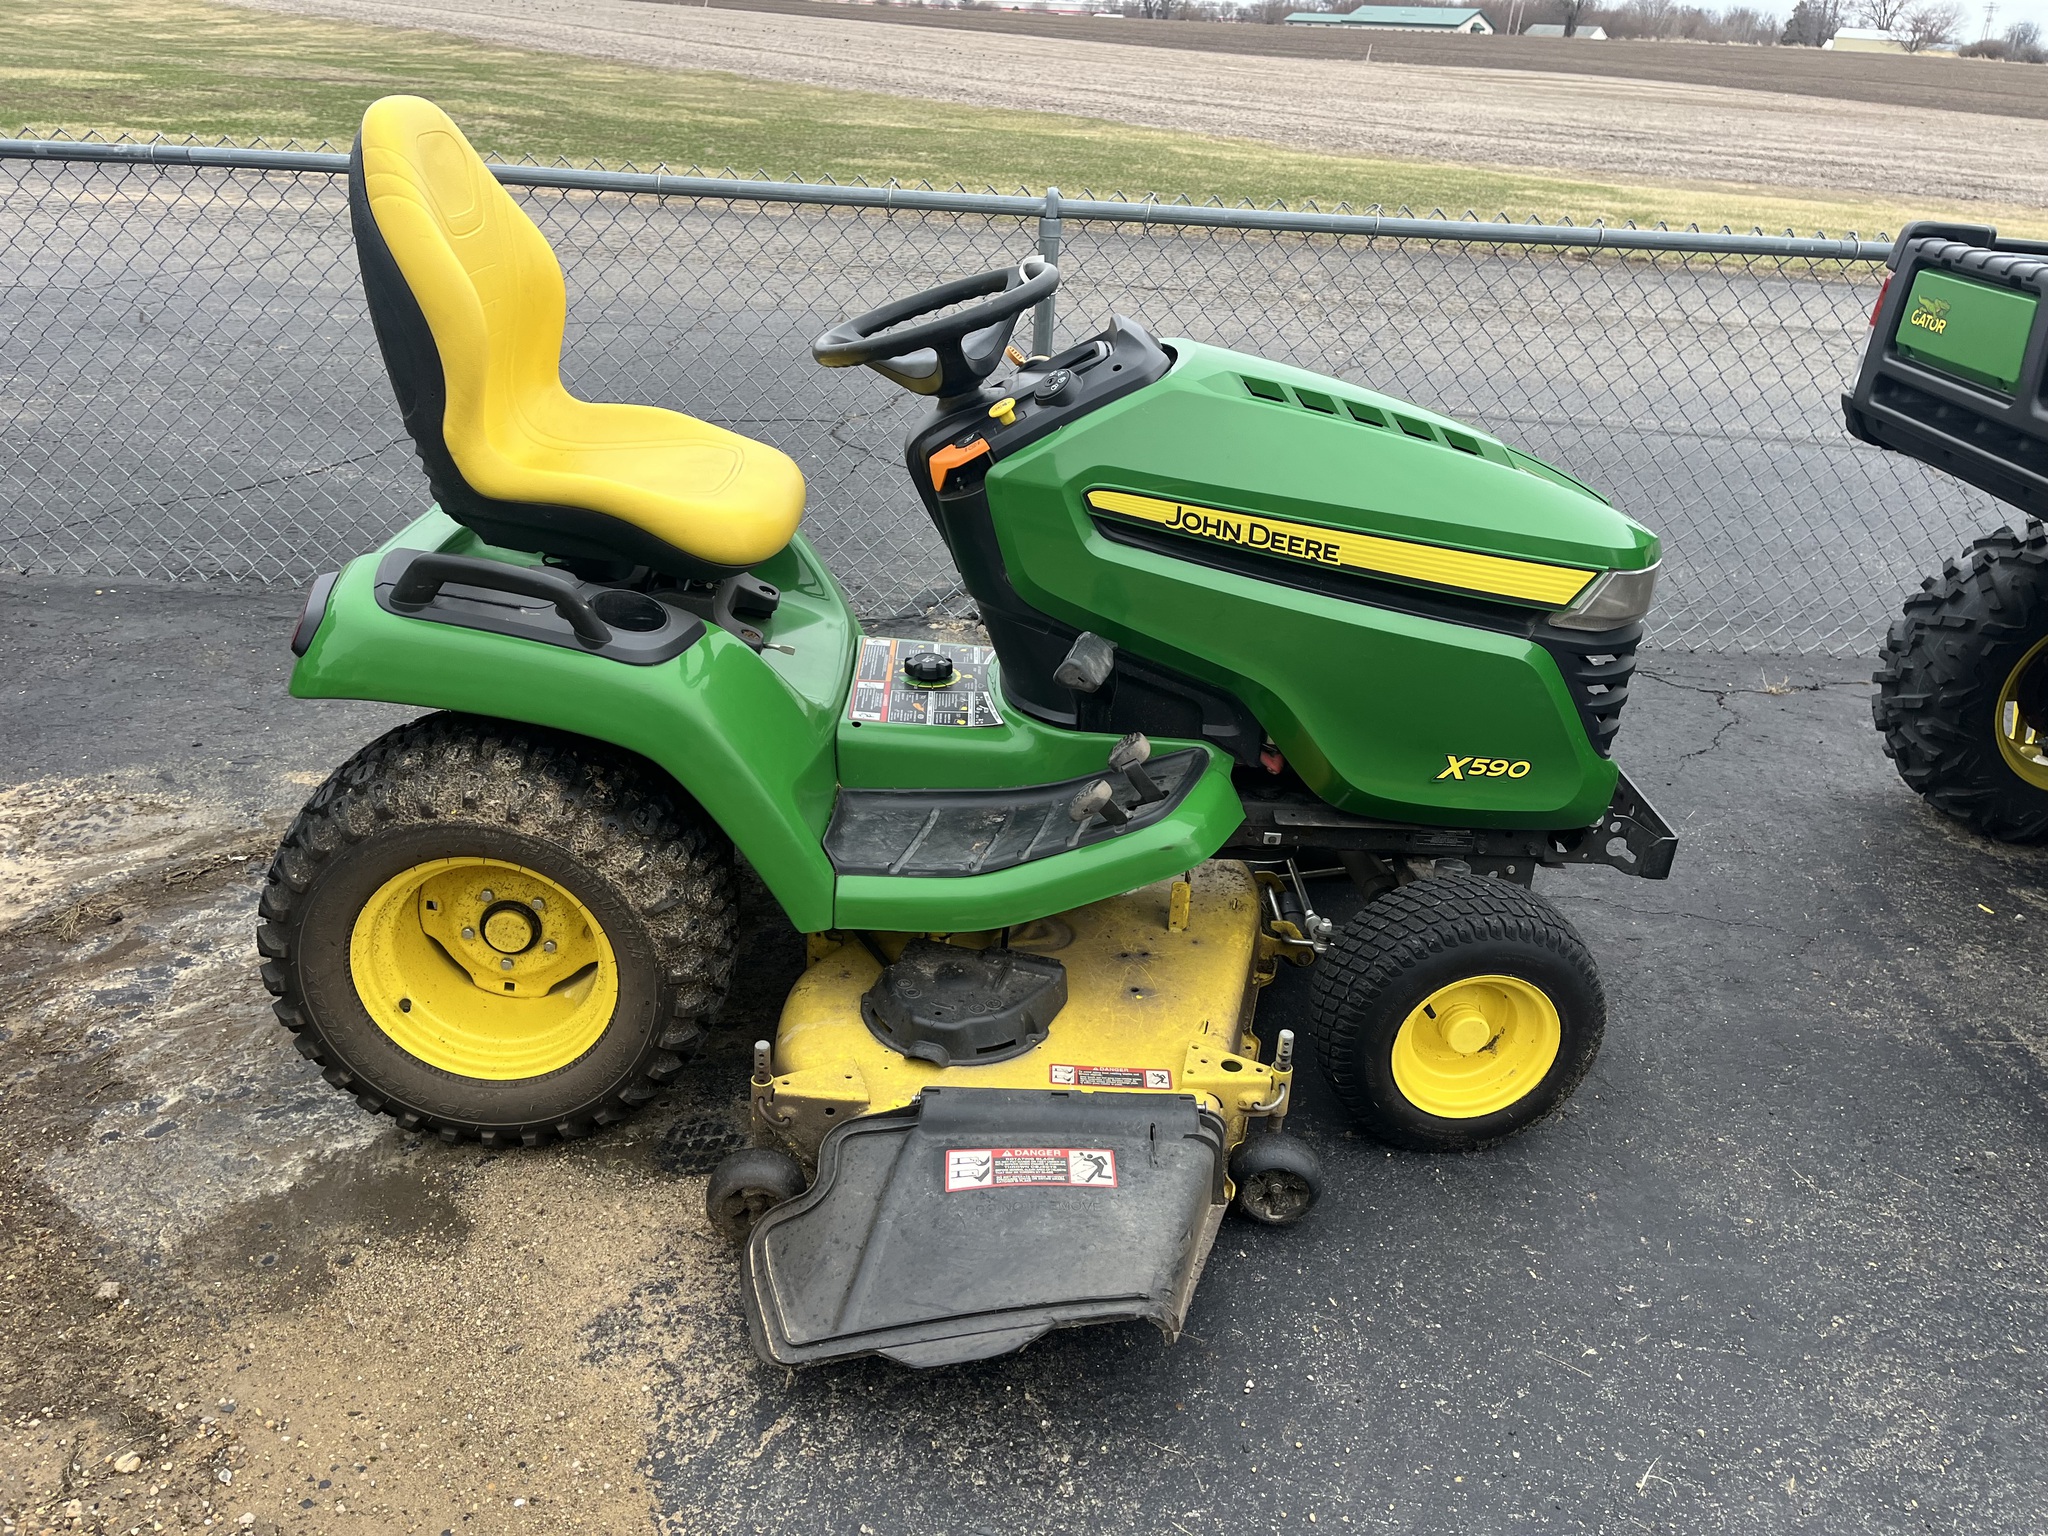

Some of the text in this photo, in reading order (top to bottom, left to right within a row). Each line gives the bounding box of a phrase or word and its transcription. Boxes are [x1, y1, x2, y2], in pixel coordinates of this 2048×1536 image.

[1910, 309, 1947, 335] GATOR
[1165, 505, 1340, 563] JOHN DEERE
[1436, 755, 1532, 781] X590
